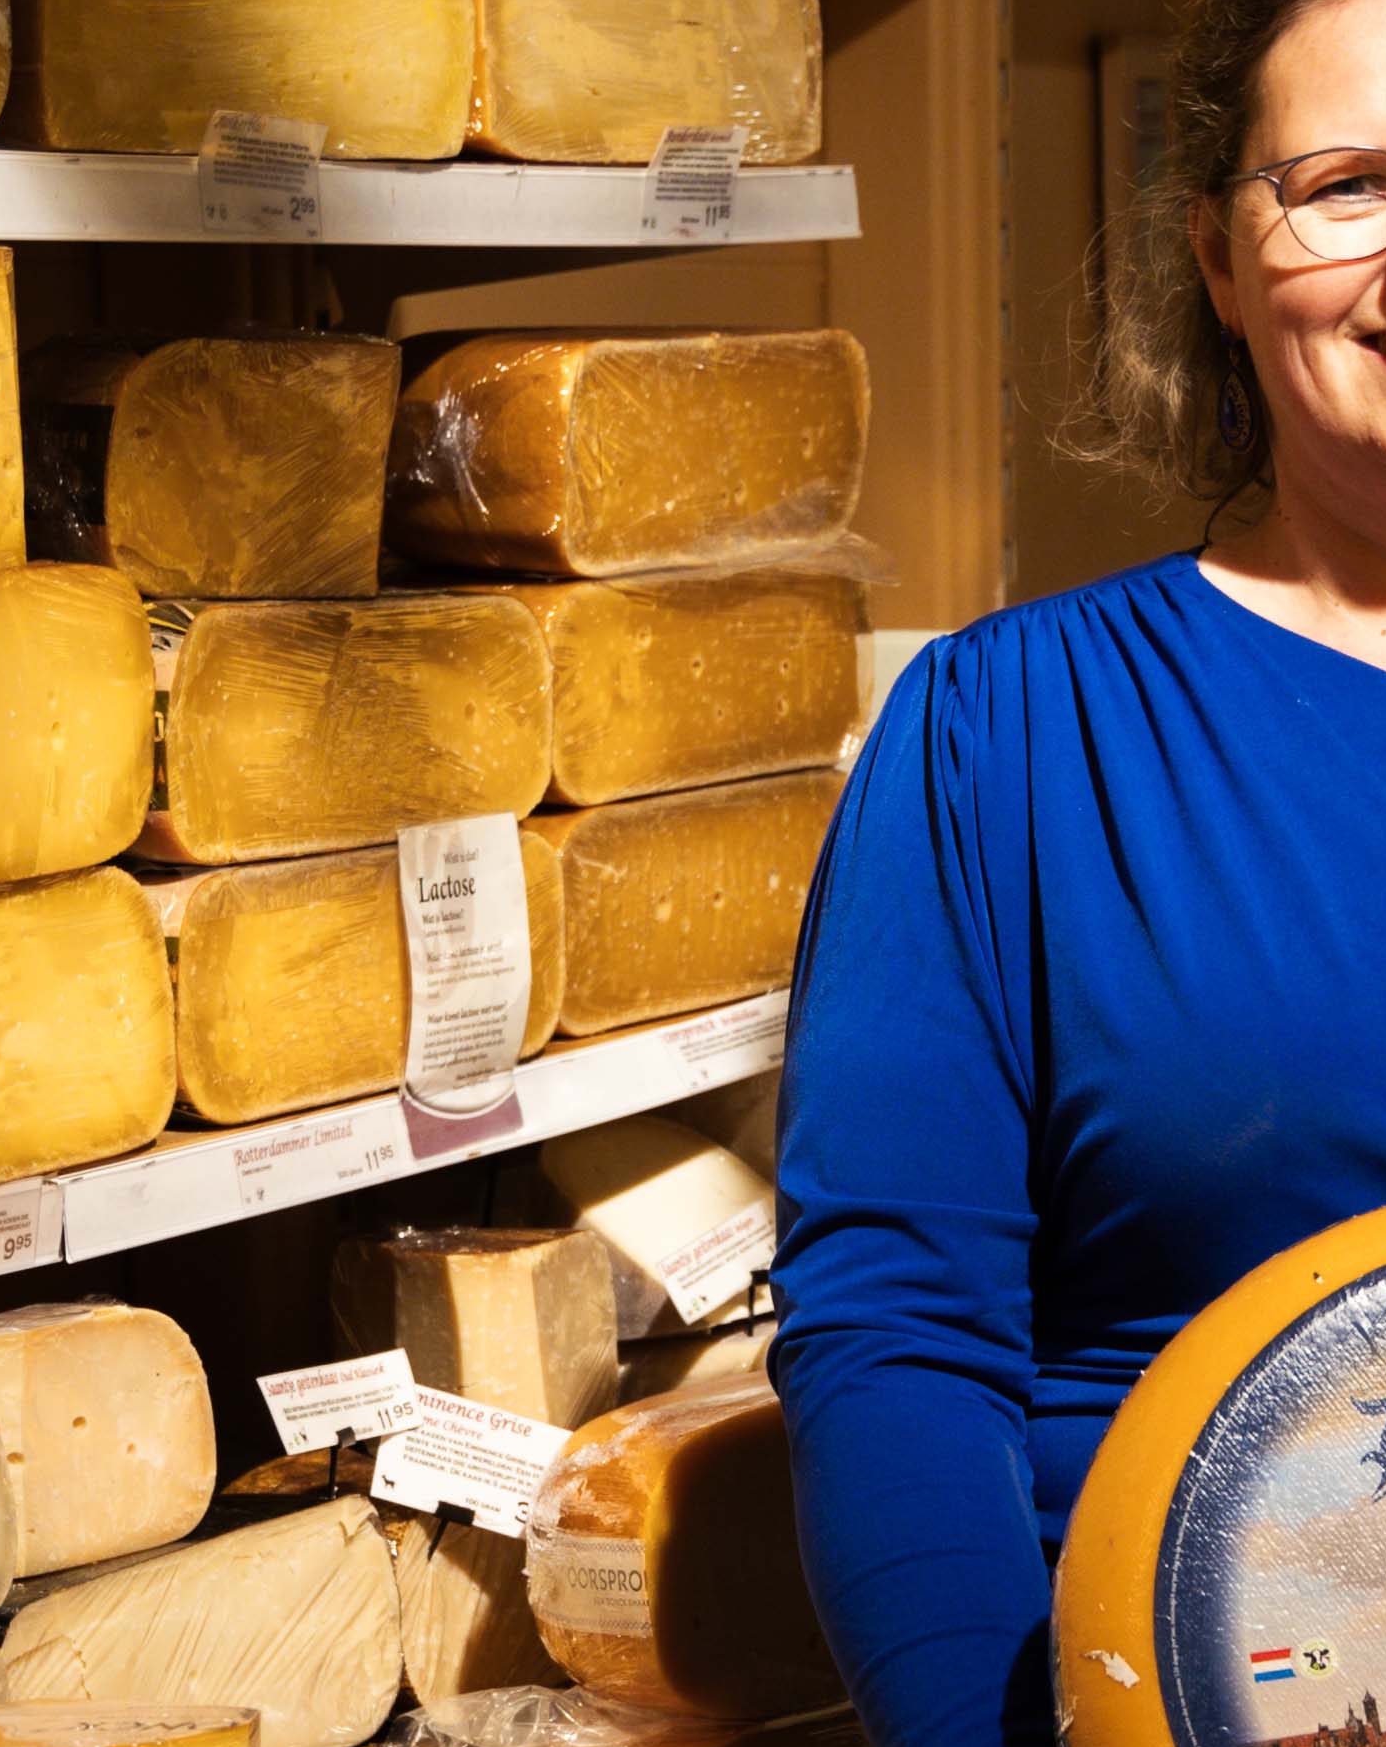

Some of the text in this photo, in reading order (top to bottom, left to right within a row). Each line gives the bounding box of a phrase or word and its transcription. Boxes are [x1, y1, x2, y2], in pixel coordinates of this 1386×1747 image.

[418, 875, 477, 904] Lactose
[236, 1118, 354, 1167] Rotterdammer Limited
[3, 1233, 33, 1260] 995
[377, 1402, 414, 1430] 1195
[489, 1412, 533, 1438] Grise
